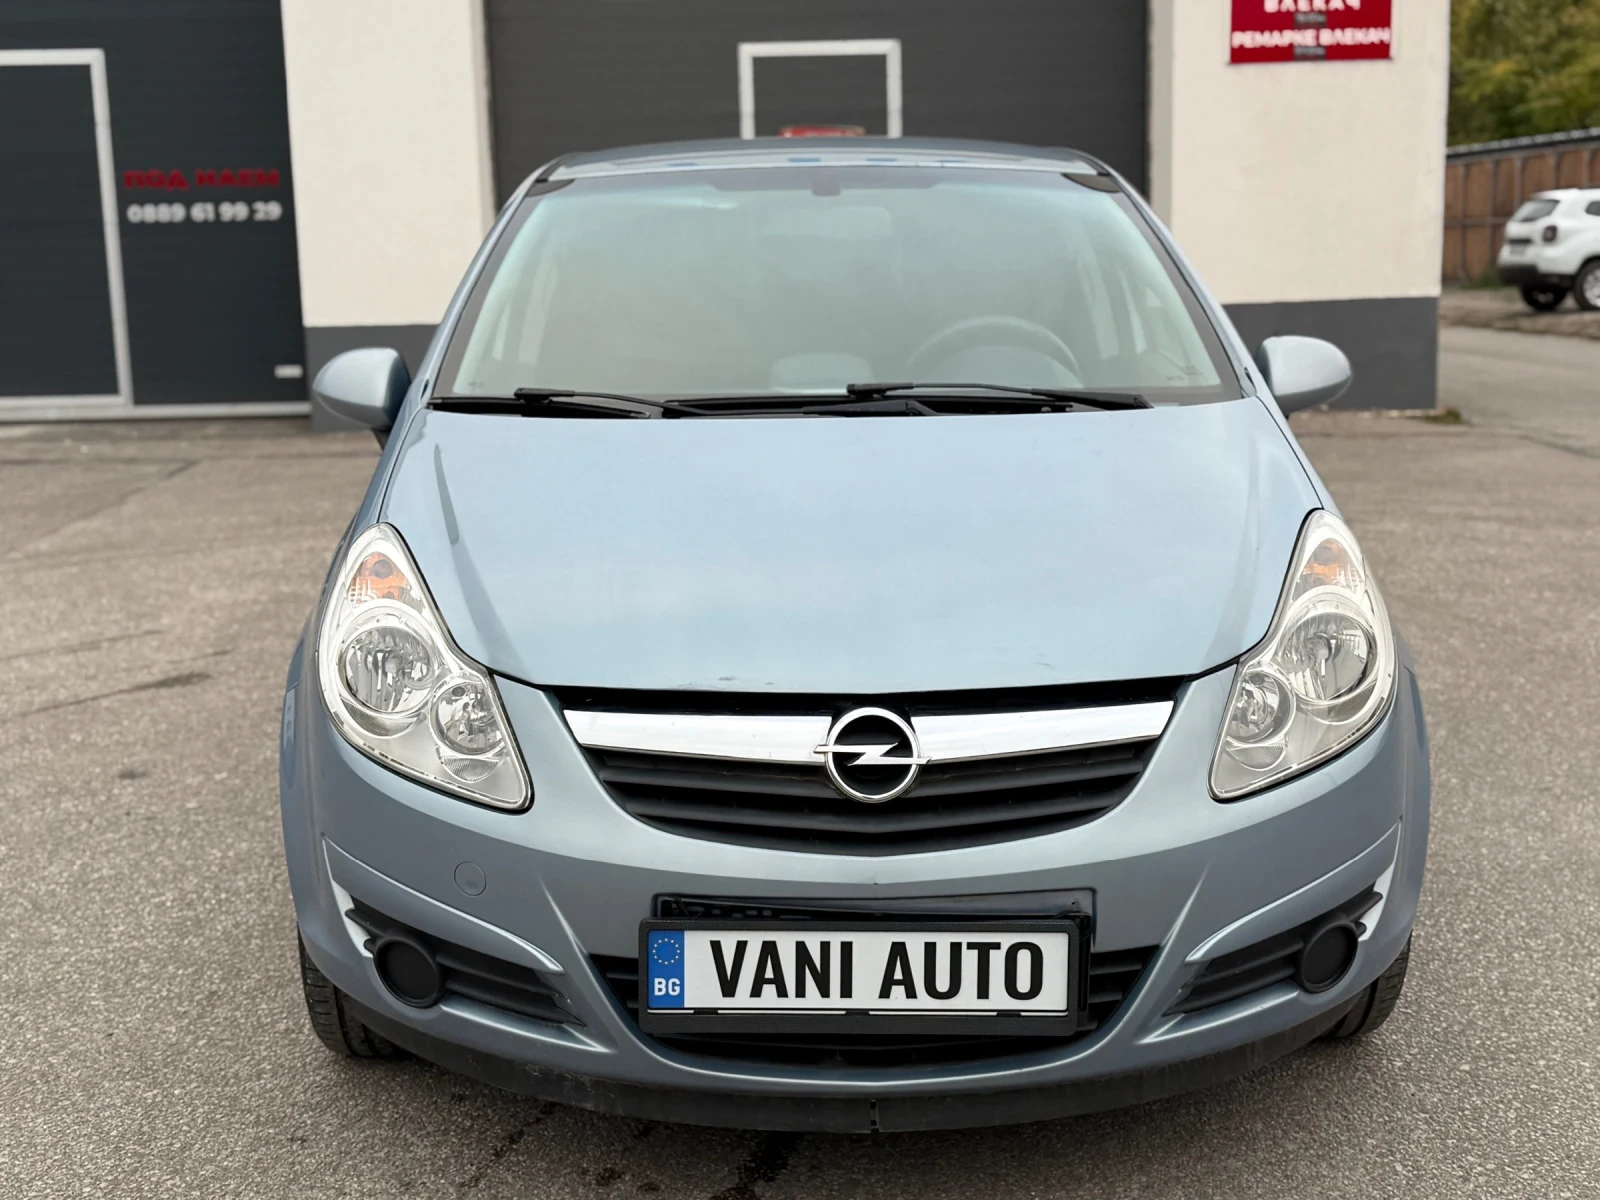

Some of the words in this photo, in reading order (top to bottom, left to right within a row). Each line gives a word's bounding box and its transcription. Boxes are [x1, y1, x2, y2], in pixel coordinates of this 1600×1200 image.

[1231, 30, 1317, 49] РЕМАРКЕ
[1319, 27, 1391, 46] ВЛЕКАЧ
[124, 169, 190, 191] ПОД
[196, 168, 280, 188] НАЕМ
[126, 203, 187, 224] 0889
[189, 202, 216, 223] 61
[218, 201, 250, 222] 99
[252, 200, 283, 222] 29
[709, 940, 854, 999] VANI
[878, 941, 1044, 1000] AUTO
[653, 977, 681, 996] BG
